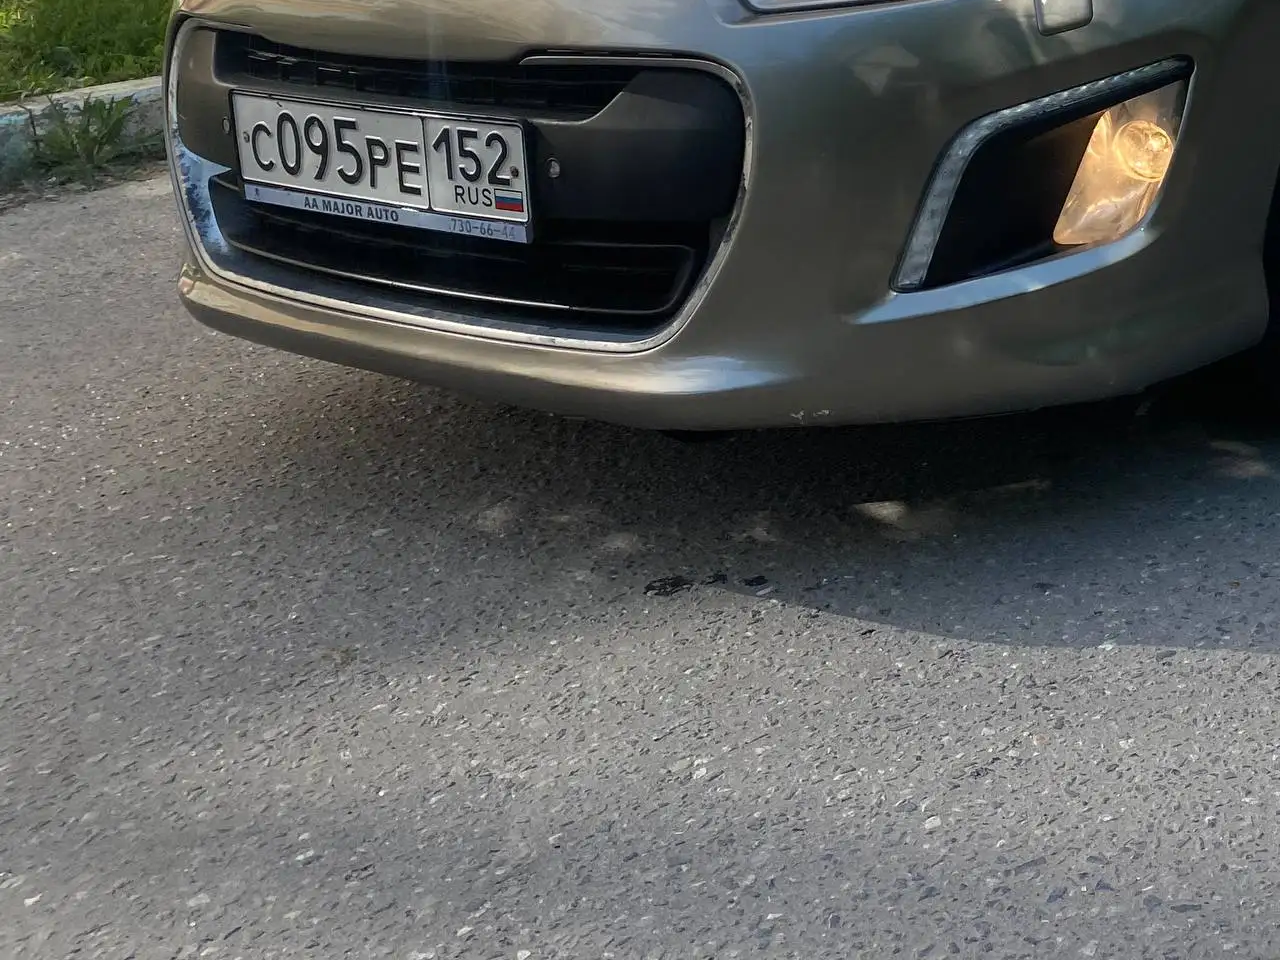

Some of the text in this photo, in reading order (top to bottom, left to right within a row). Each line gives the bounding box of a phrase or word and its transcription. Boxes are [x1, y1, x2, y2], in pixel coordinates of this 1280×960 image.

[432, 125, 511, 187] 152
[304, 196, 399, 222] AA MAJOR AUTO
[454, 185, 493, 207] RUS
